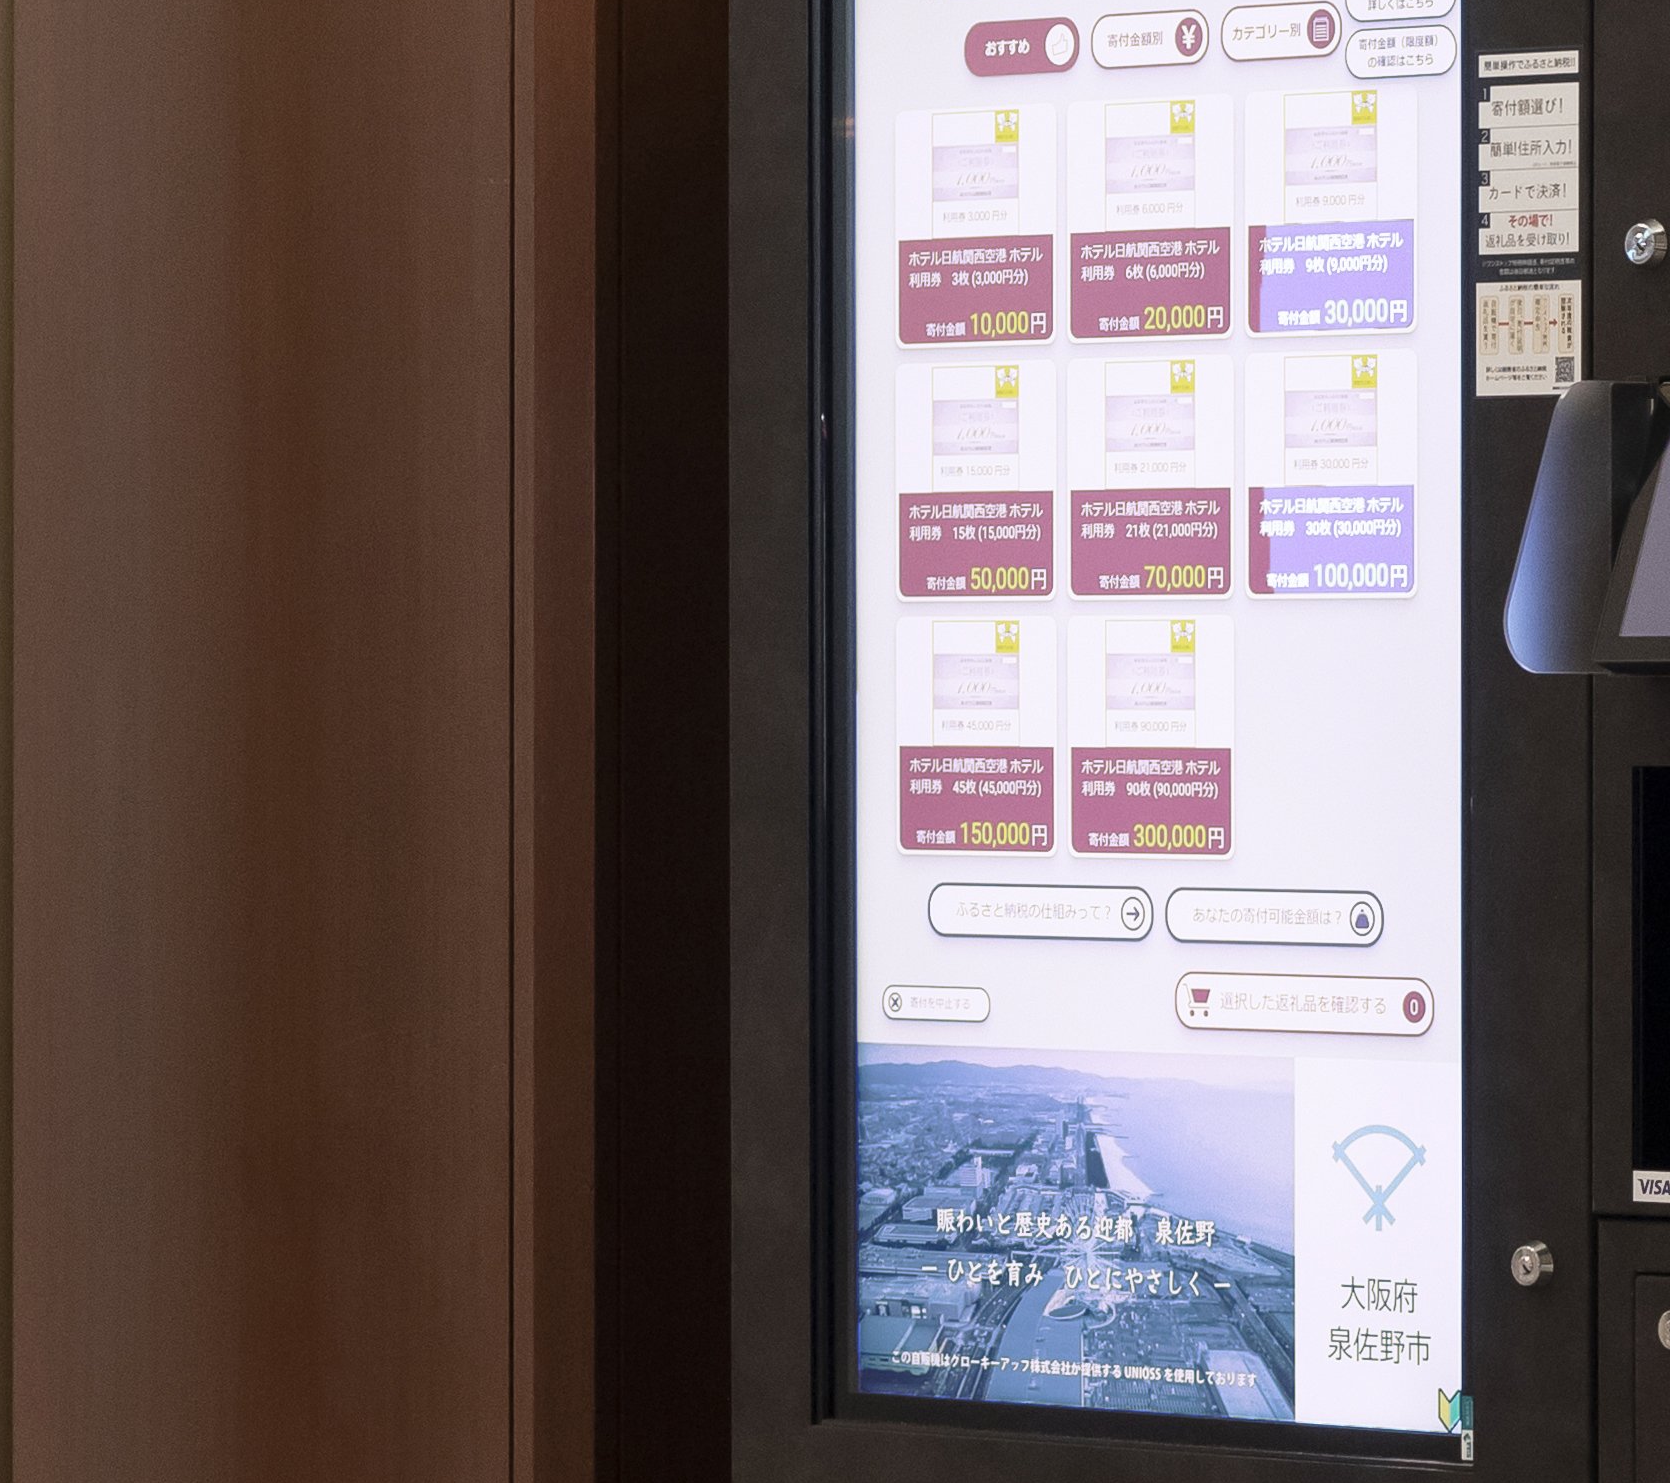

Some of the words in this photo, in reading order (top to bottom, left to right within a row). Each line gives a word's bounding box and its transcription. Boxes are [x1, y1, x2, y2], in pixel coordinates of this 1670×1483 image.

[1107, 30, 1163, 49] 寄付金額別
[1231, 22, 1301, 41] カテゴリー別
[985, 38, 1030, 57] おすすめ
[1481, 131, 1488, 143] 2
[1481, 173, 1488, 185] 3
[1481, 214, 1489, 227] 4
[1185, 240, 1220, 256] ホテル
[1366, 232, 1404, 249] ホテル
[1009, 247, 1043, 262] ホテル
[1080, 265, 1115, 282] 利用券
[1125, 265, 1144, 280] 6枚
[1259, 257, 1294, 276] 利用券
[1305, 256, 1325, 273] 9枚
[909, 271, 942, 288] 利用券
[952, 272, 970, 286] 3枚
[1143, 305, 1224, 332] 20,000円
[1324, 298, 1408, 324] 30,000円
[970, 312, 1047, 337] 10,000円
[1009, 503, 1043, 518] ホテル
[1185, 500, 1220, 515] ホテル
[1367, 497, 1404, 513] ホテル
[909, 525, 942, 541] 利用券
[952, 525, 976, 540] 15枚
[1081, 523, 1115, 539] 利用券
[1125, 522, 1151, 538] 21枚
[1259, 520, 1295, 537] 利用券
[1305, 519, 1332, 536] 30枚
[970, 567, 1047, 593] 50,000円
[1144, 565, 1224, 592] 70,000円
[1314, 563, 1408, 589] 100,000円
[1009, 758, 1044, 775] ホテル
[1185, 759, 1221, 776] ホテル
[910, 779, 942, 795] 利用券
[953, 780, 976, 795] 45枚
[1081, 780, 1115, 797] 利用券
[1127, 781, 1151, 797] 90枚
[960, 821, 1048, 847] 150,000円
[1133, 824, 1225, 851] 300,000円
[1220, 991, 1387, 1015] 選択した返礼品を確認する
[1638, 1179, 1670, 1195] VISA
[936, 1208, 1134, 1243] 賑わいと歴史ある迎都
[1155, 1219, 1216, 1248] 泉佐野
[947, 1258, 1043, 1287] ひとを育み
[1065, 1264, 1200, 1296] ひとにやさしく
[1341, 1277, 1418, 1314] 大阪府
[1328, 1327, 1431, 1365] 泉佐野市
[1124, 1367, 1161, 1381] UNIOSS
[1164, 1368, 1257, 1388] を使用しております
